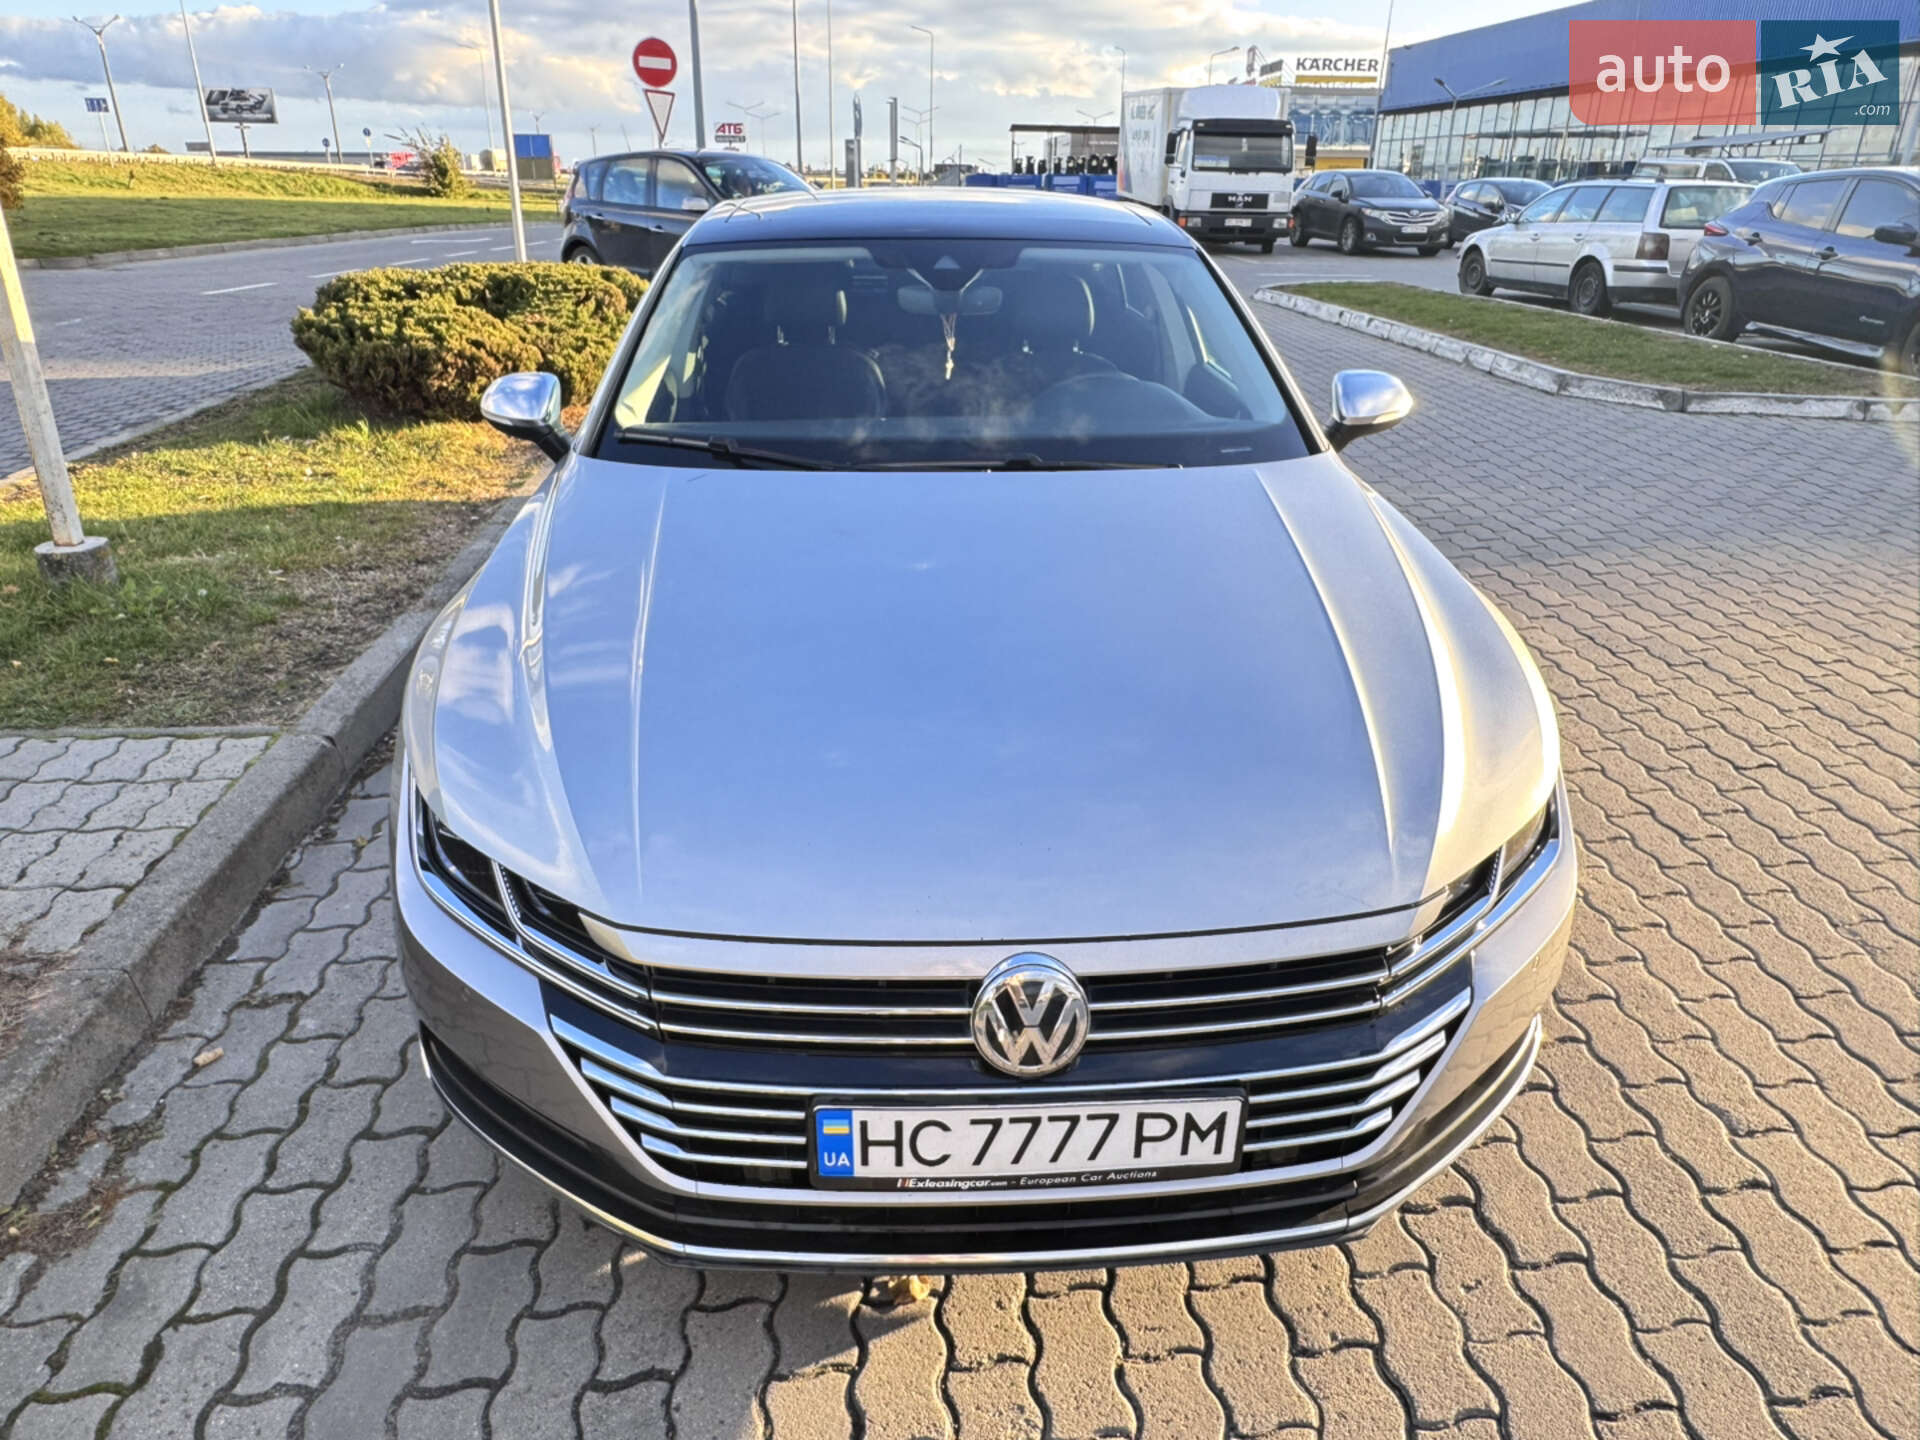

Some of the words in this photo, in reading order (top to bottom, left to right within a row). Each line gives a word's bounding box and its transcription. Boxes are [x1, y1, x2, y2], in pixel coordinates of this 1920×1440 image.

[1296, 57, 1379, 72] KÄRCHER
[859, 1119, 953, 1167] HC
[969, 1112, 1120, 1167] 7777
[1133, 1111, 1228, 1159] PM
[823, 1151, 851, 1167] UA
[1020, 1176, 1077, 1186] European
[1080, 1173, 1103, 1182] Car
[1106, 1170, 1158, 1181] Auctions
